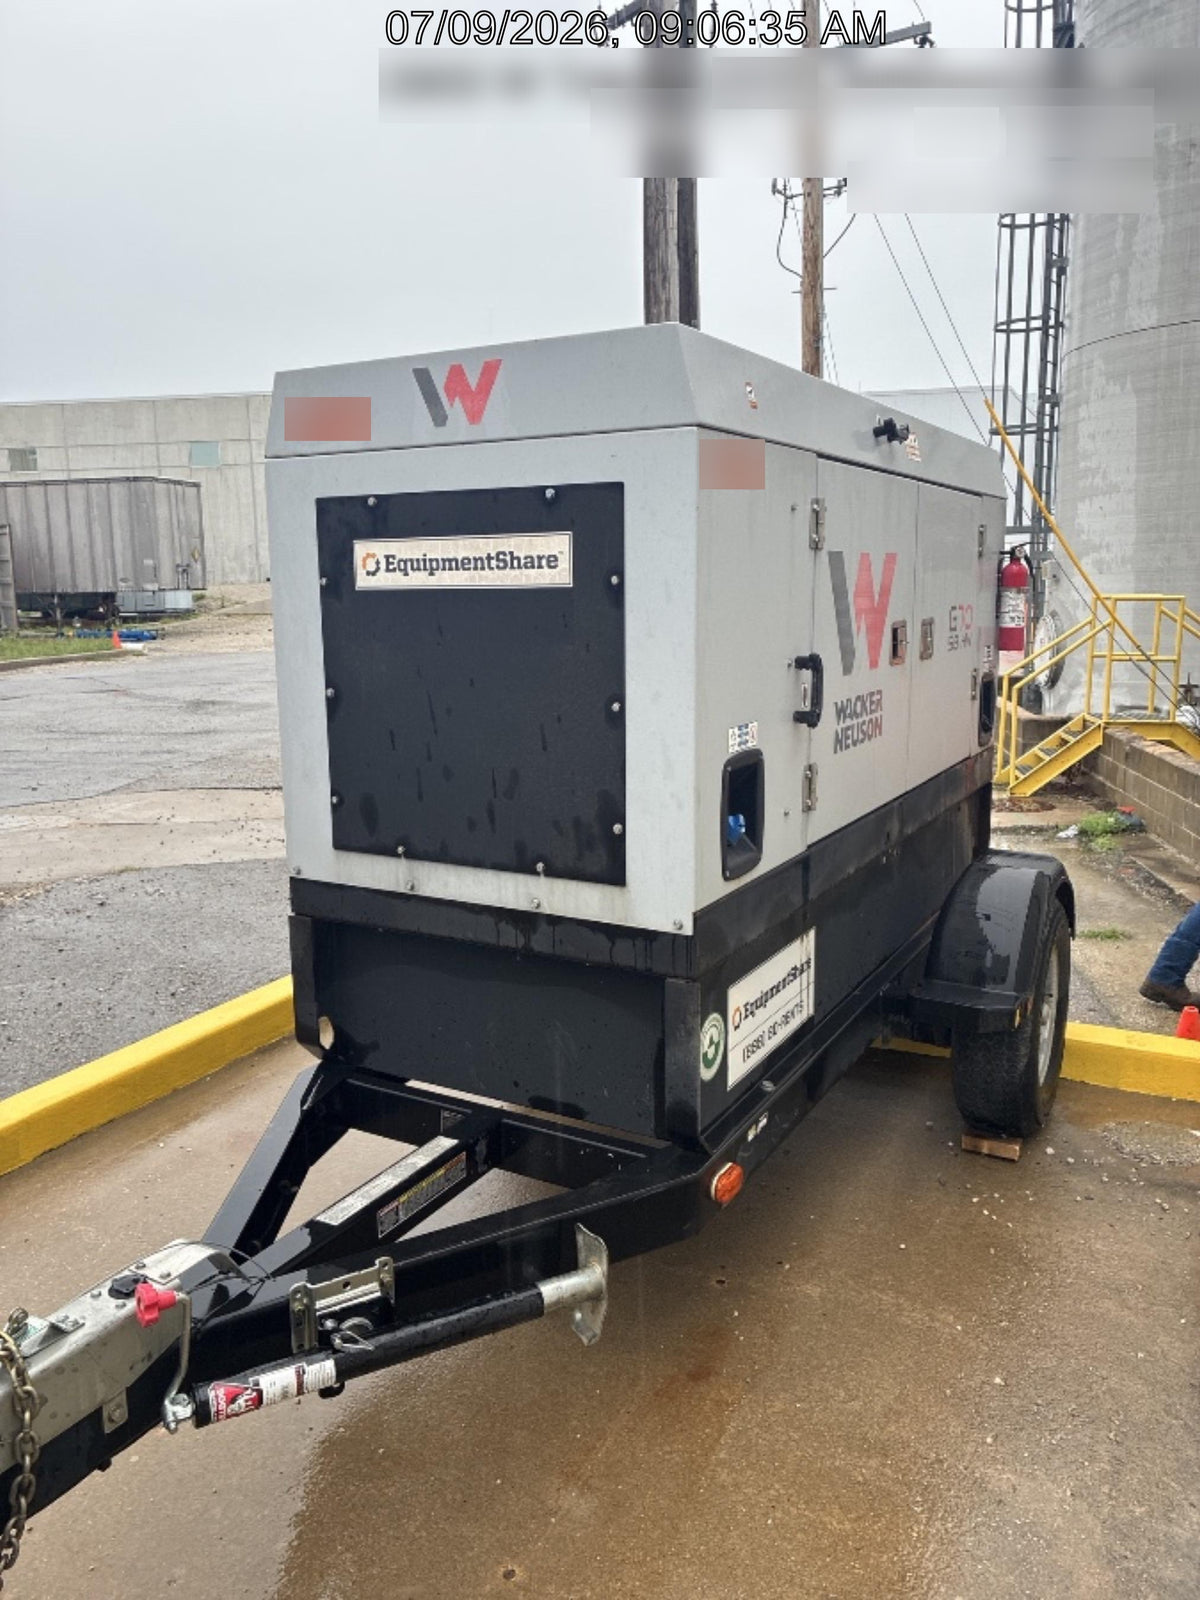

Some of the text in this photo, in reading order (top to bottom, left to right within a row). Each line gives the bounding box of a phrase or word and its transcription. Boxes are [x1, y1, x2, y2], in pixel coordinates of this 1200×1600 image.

[384, 551, 559, 576] EquipmentShare
[833, 689, 882, 726] WACKER
[833, 714, 882, 754] NEUSON
[743, 957, 812, 1021] EquipmentShare
